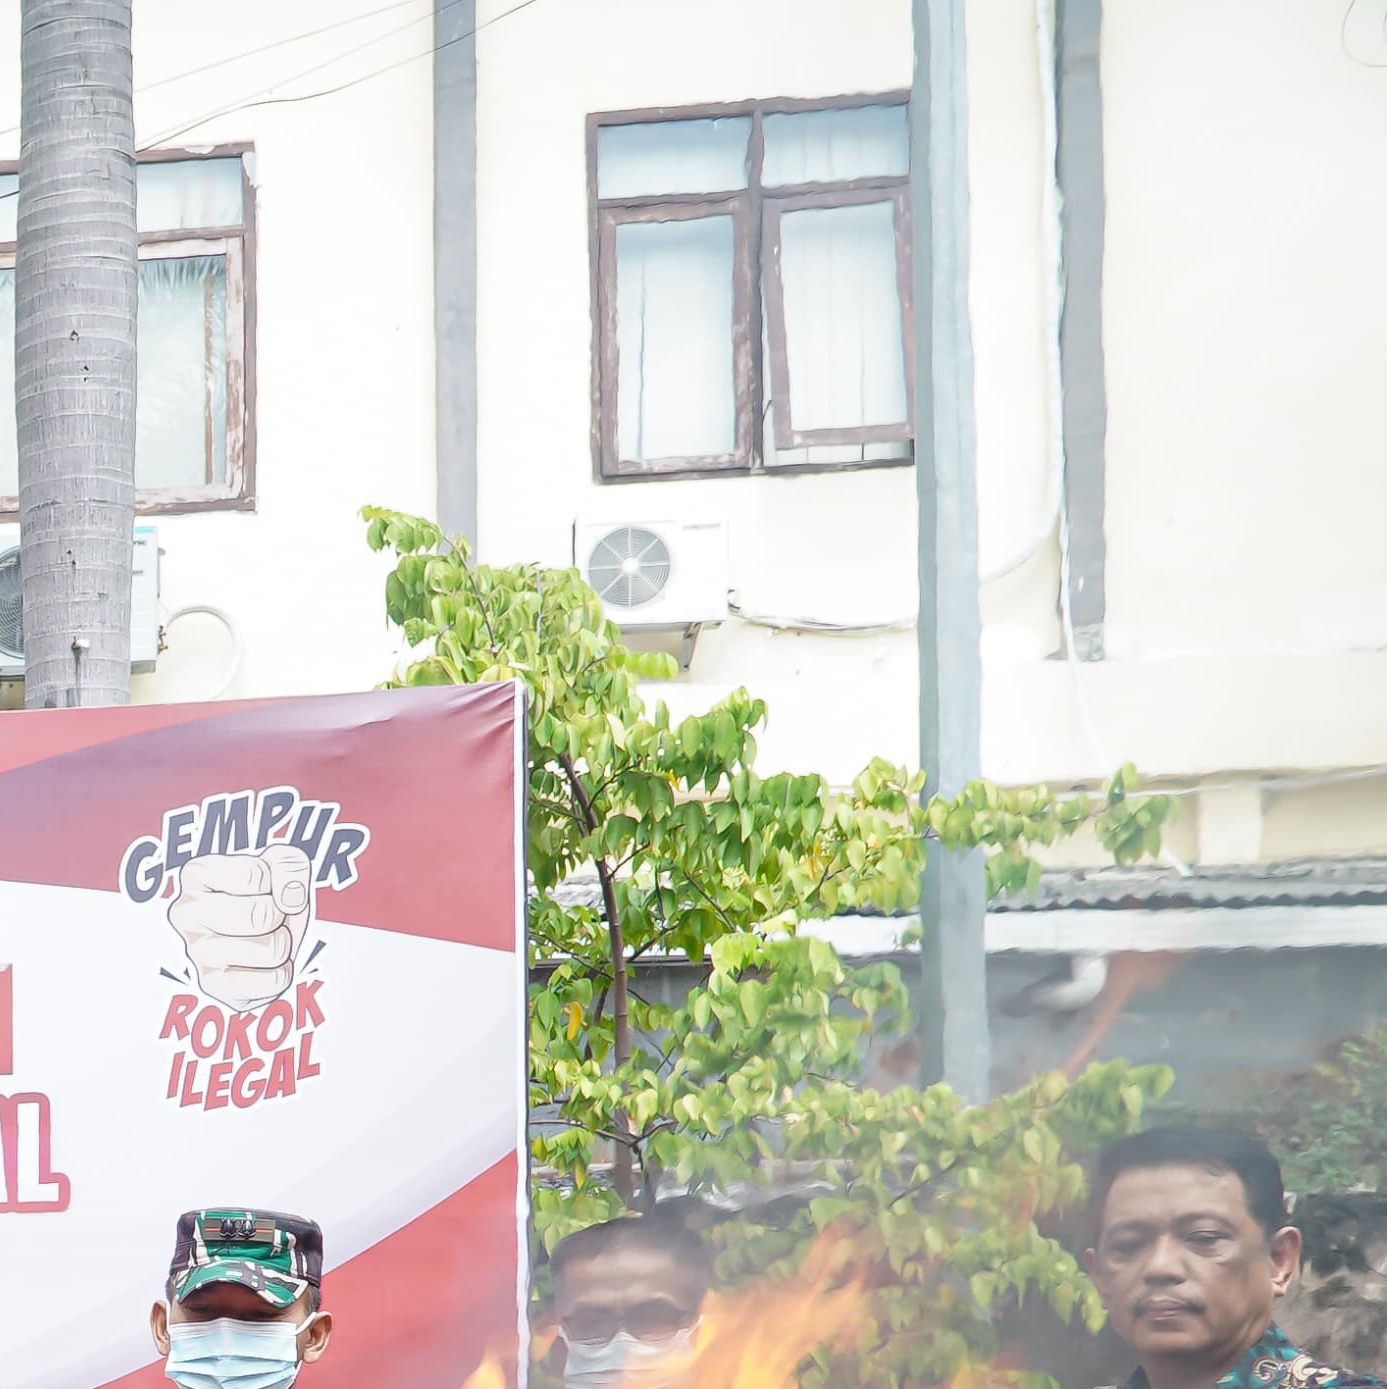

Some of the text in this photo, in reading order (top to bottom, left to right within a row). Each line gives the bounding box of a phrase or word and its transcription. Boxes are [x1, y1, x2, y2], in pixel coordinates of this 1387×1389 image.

[124, 790, 365, 903] GEMPUR
[159, 979, 325, 1061] ROKOK
[166, 1032, 321, 1112] ILEGAL
